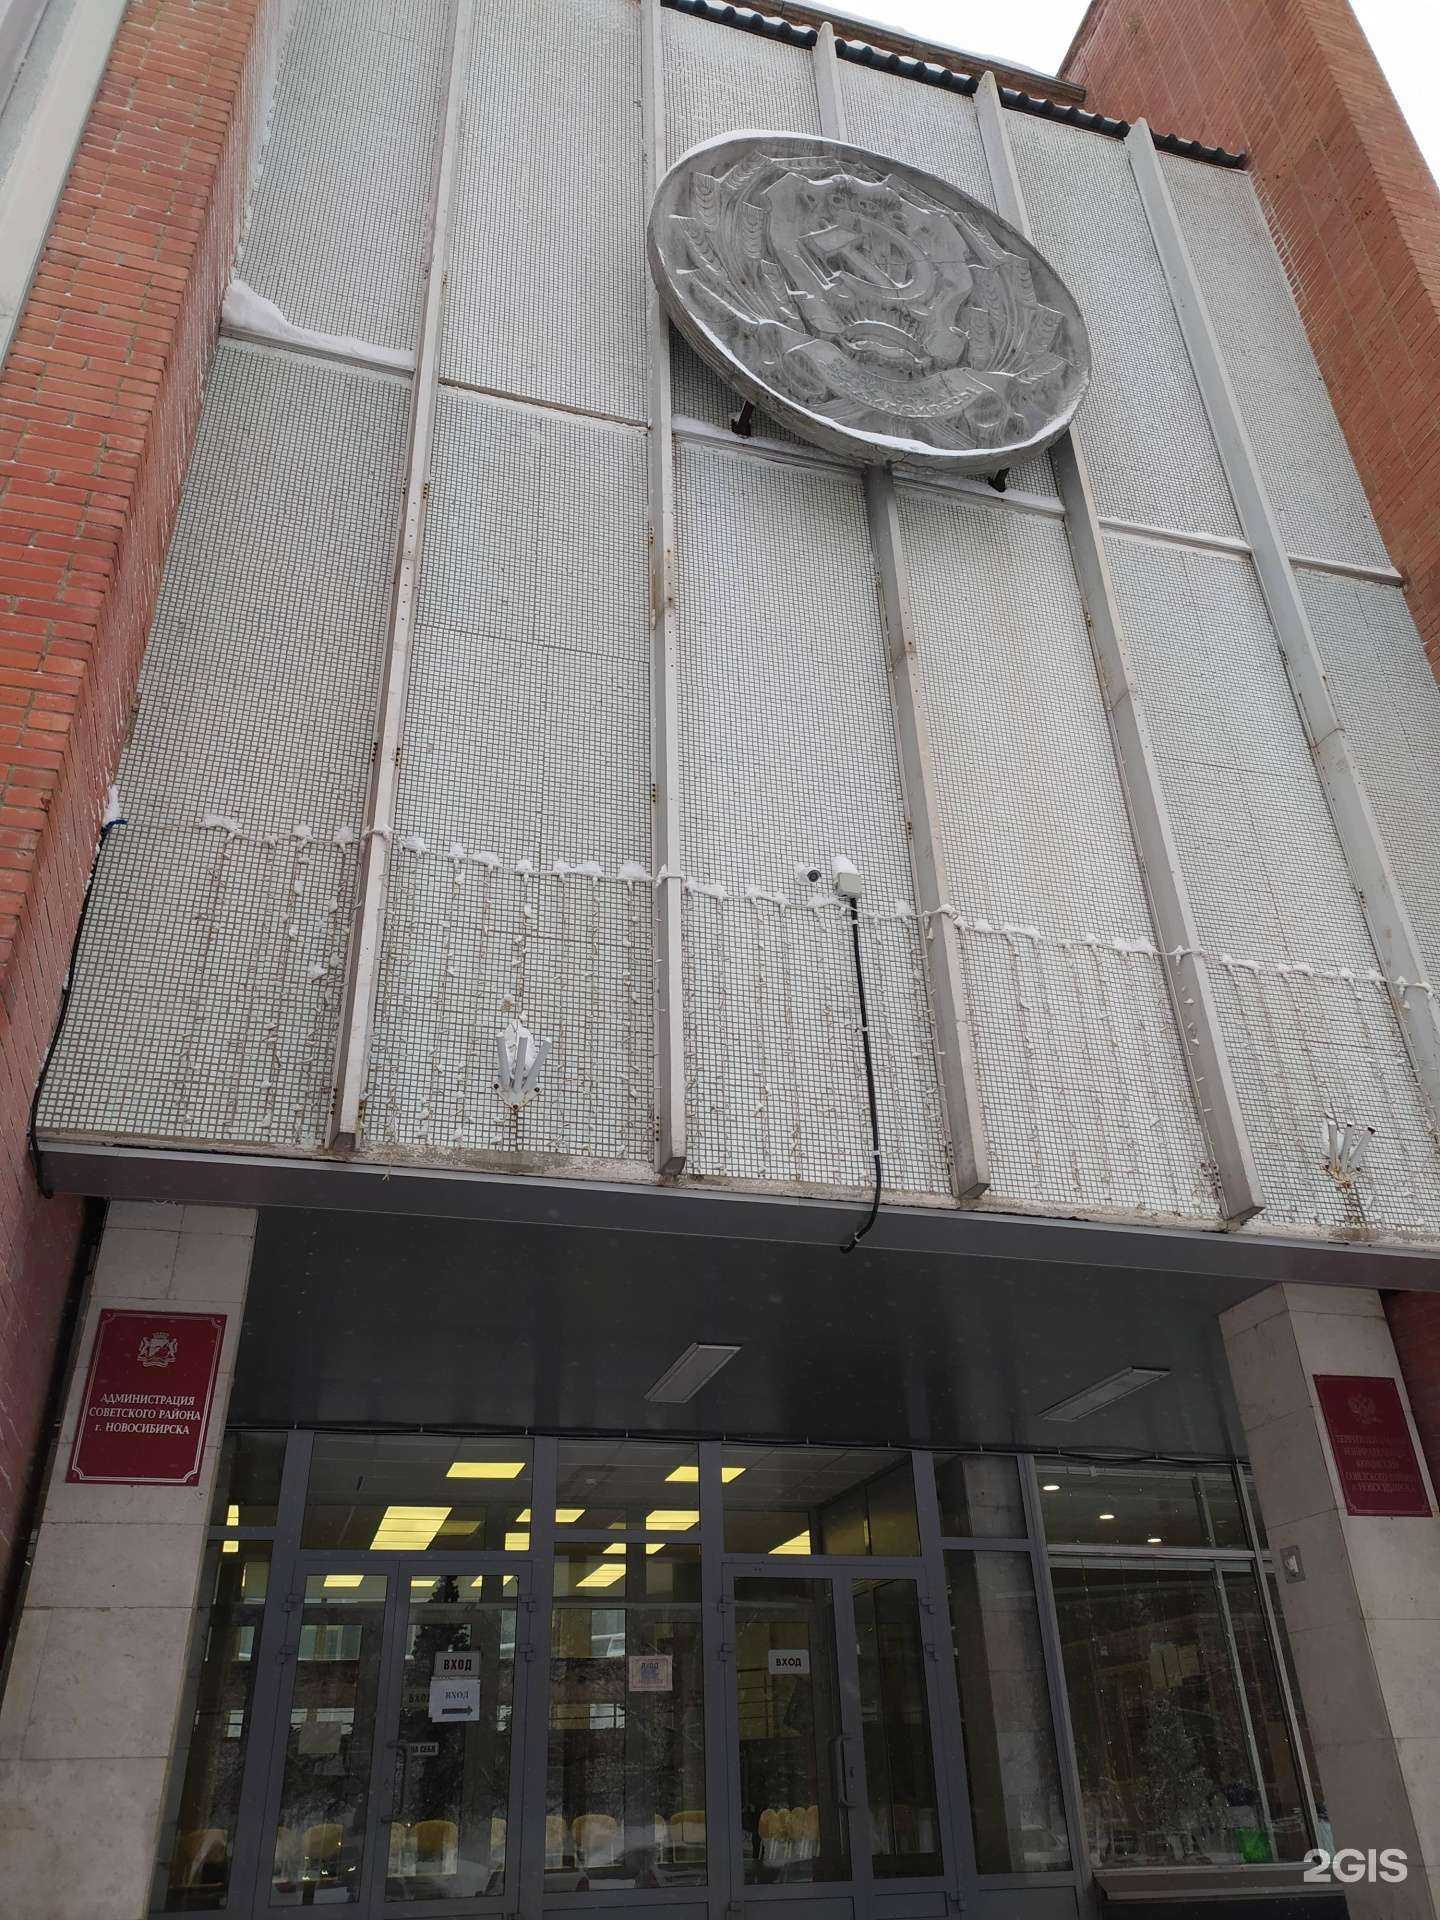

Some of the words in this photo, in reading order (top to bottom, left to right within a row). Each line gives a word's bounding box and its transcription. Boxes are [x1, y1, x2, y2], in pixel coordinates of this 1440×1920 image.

[100, 1394, 195, 1406] АДМИНИСТРАЦИЯ
[89, 1407, 156, 1419] СОВЕТСКОГО
[159, 1408, 201, 1420] РАЙОНА
[106, 1422, 190, 1434] НОВОСИБИРСКА
[443, 1659, 472, 1671] ВХОД
[776, 1658, 802, 1667] ВХОД
